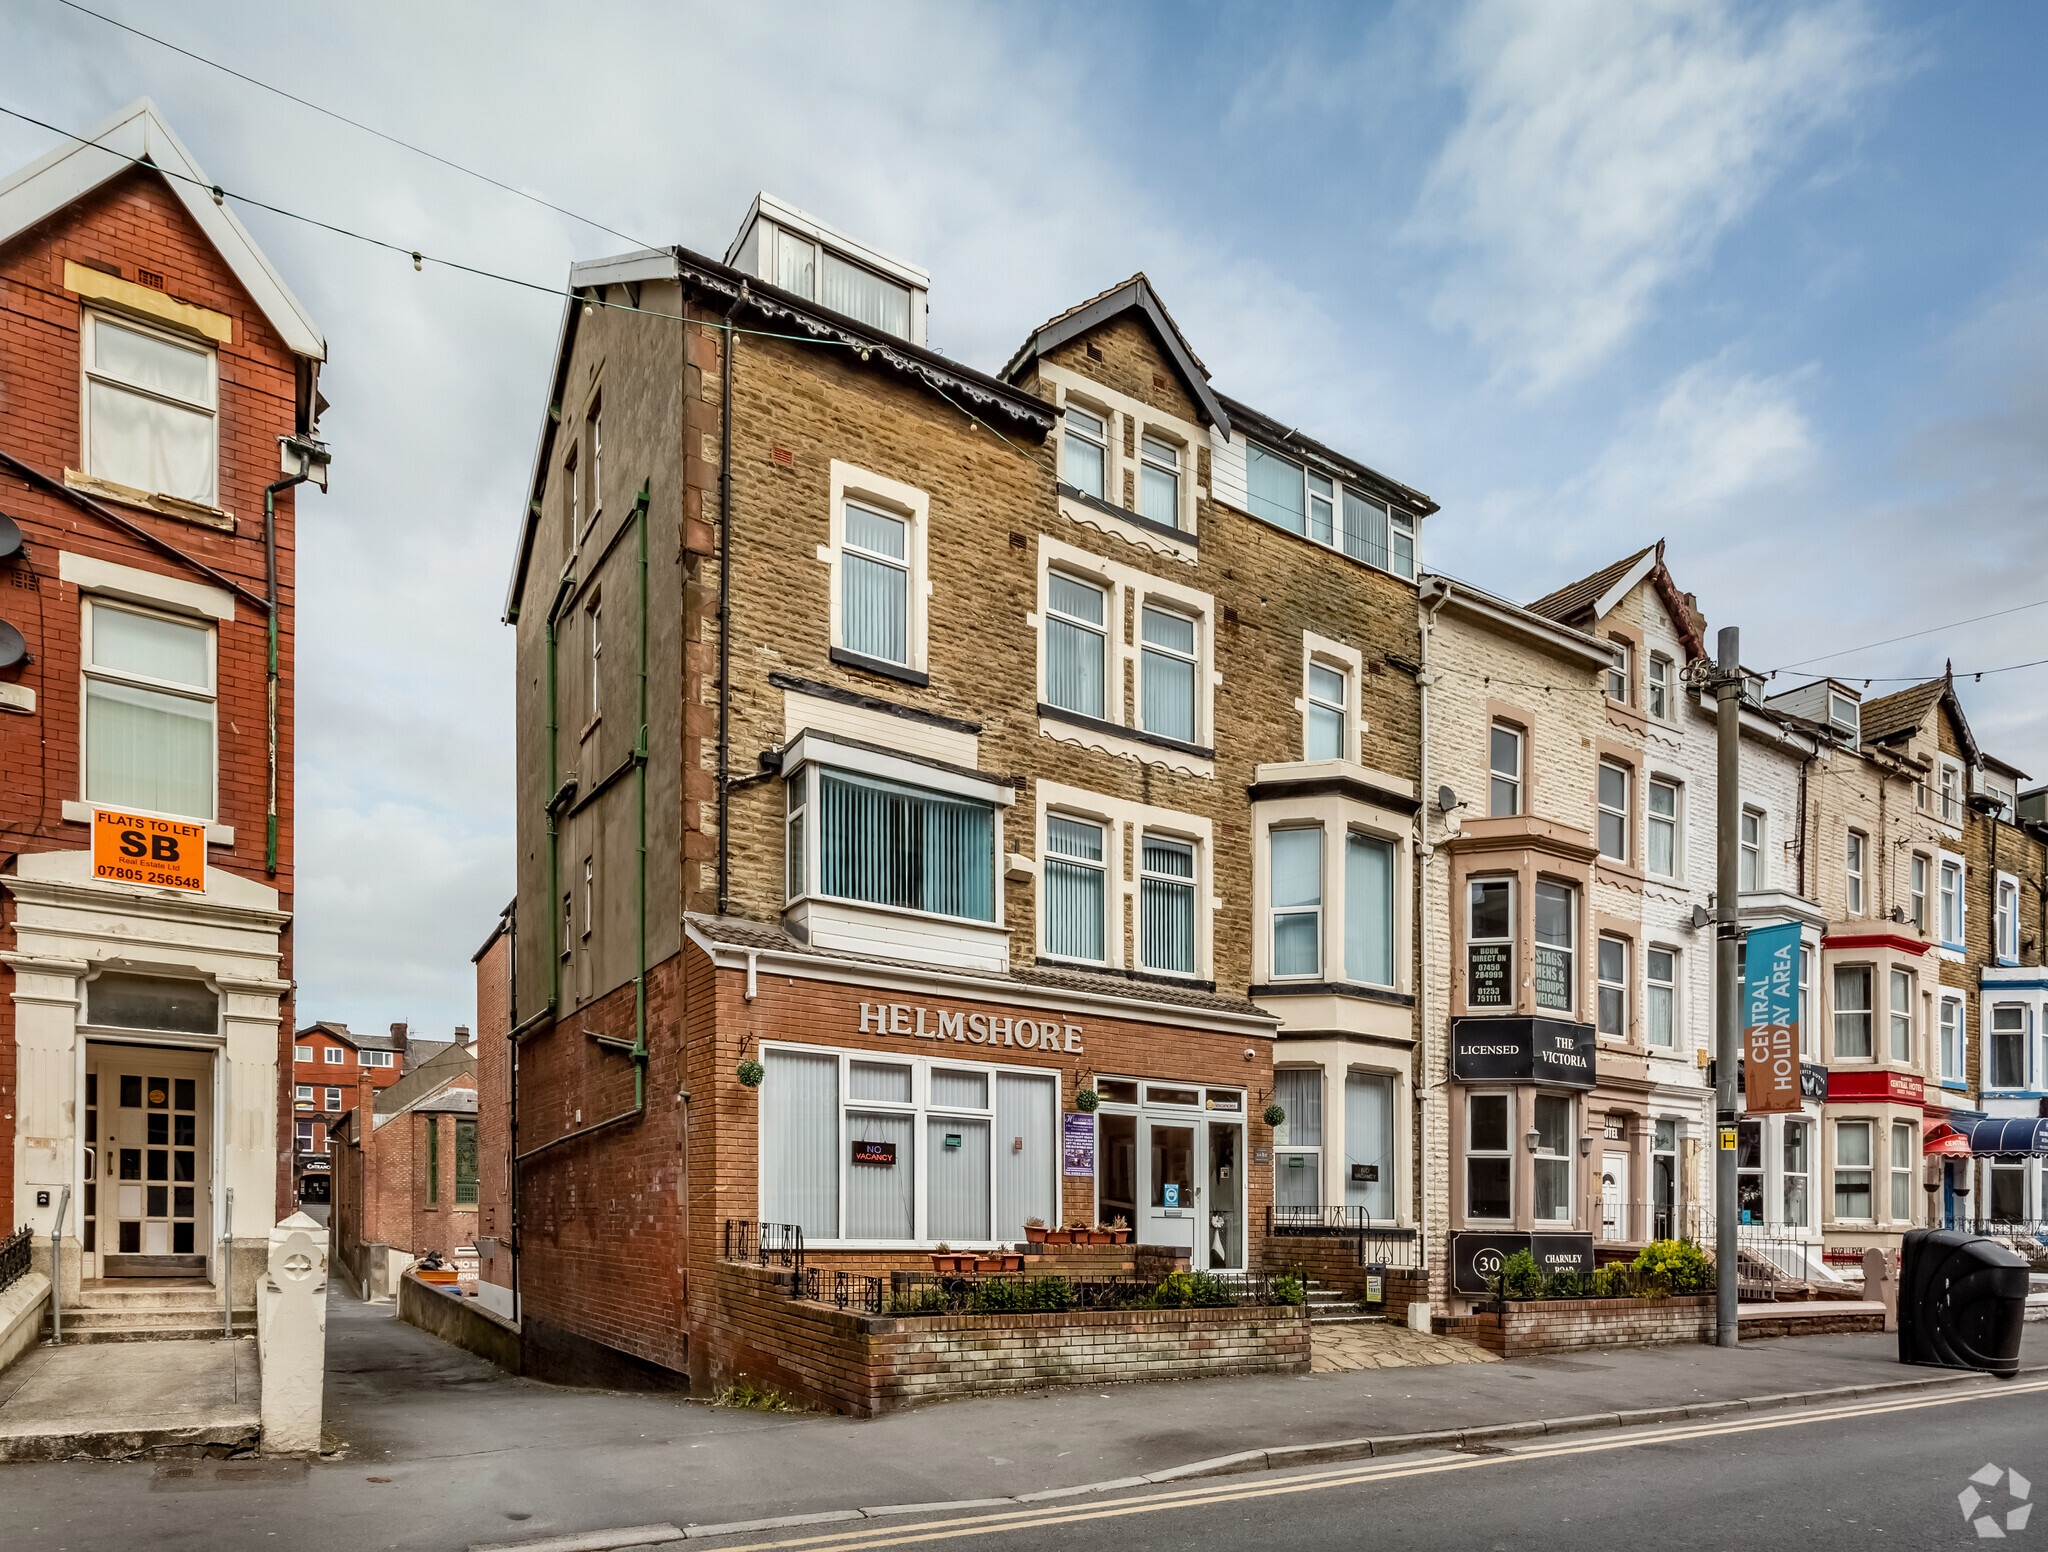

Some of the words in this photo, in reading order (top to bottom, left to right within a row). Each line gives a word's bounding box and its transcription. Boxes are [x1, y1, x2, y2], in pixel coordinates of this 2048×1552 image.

[98, 812, 144, 829] FLATS
[149, 820, 169, 832] TO
[173, 825, 200, 837] LET
[119, 830, 180, 862] SB
[118, 856, 138, 865] Real
[140, 860, 165, 870] Estate
[167, 864, 180, 872] Ltd
[97, 865, 143, 881] 07805
[147, 872, 200, 889] 256548
[1497, 954, 1507, 962] ON
[1535, 949, 1565, 969] STAGS,
[1535, 963, 1557, 981] HENS
[1558, 970, 1565, 982] &
[1772, 943, 1792, 998] AREA
[1477, 987, 1500, 995] 01253
[1536, 978, 1565, 996] GROUPS
[1535, 991, 1567, 1009] WELCOME
[858, 1002, 1084, 1054] HELMSHORE
[1751, 975, 1770, 1064] CENTRAL
[1460, 1045, 1520, 1055] LICENSED
[1555, 1036, 1574, 1050] THE
[1772, 1005, 1793, 1091] HOLIDAY
[1542, 1050, 1588, 1068] VICTORIA
[1604, 1127, 1619, 1140] OTEL
[1723, 1134, 1735, 1148] H
[856, 1152, 893, 1162] VACANCY
[866, 1145, 882, 1154] NO
[1479, 1257, 1500, 1272] 30
[1545, 1254, 1582, 1264] CHARNLEY
